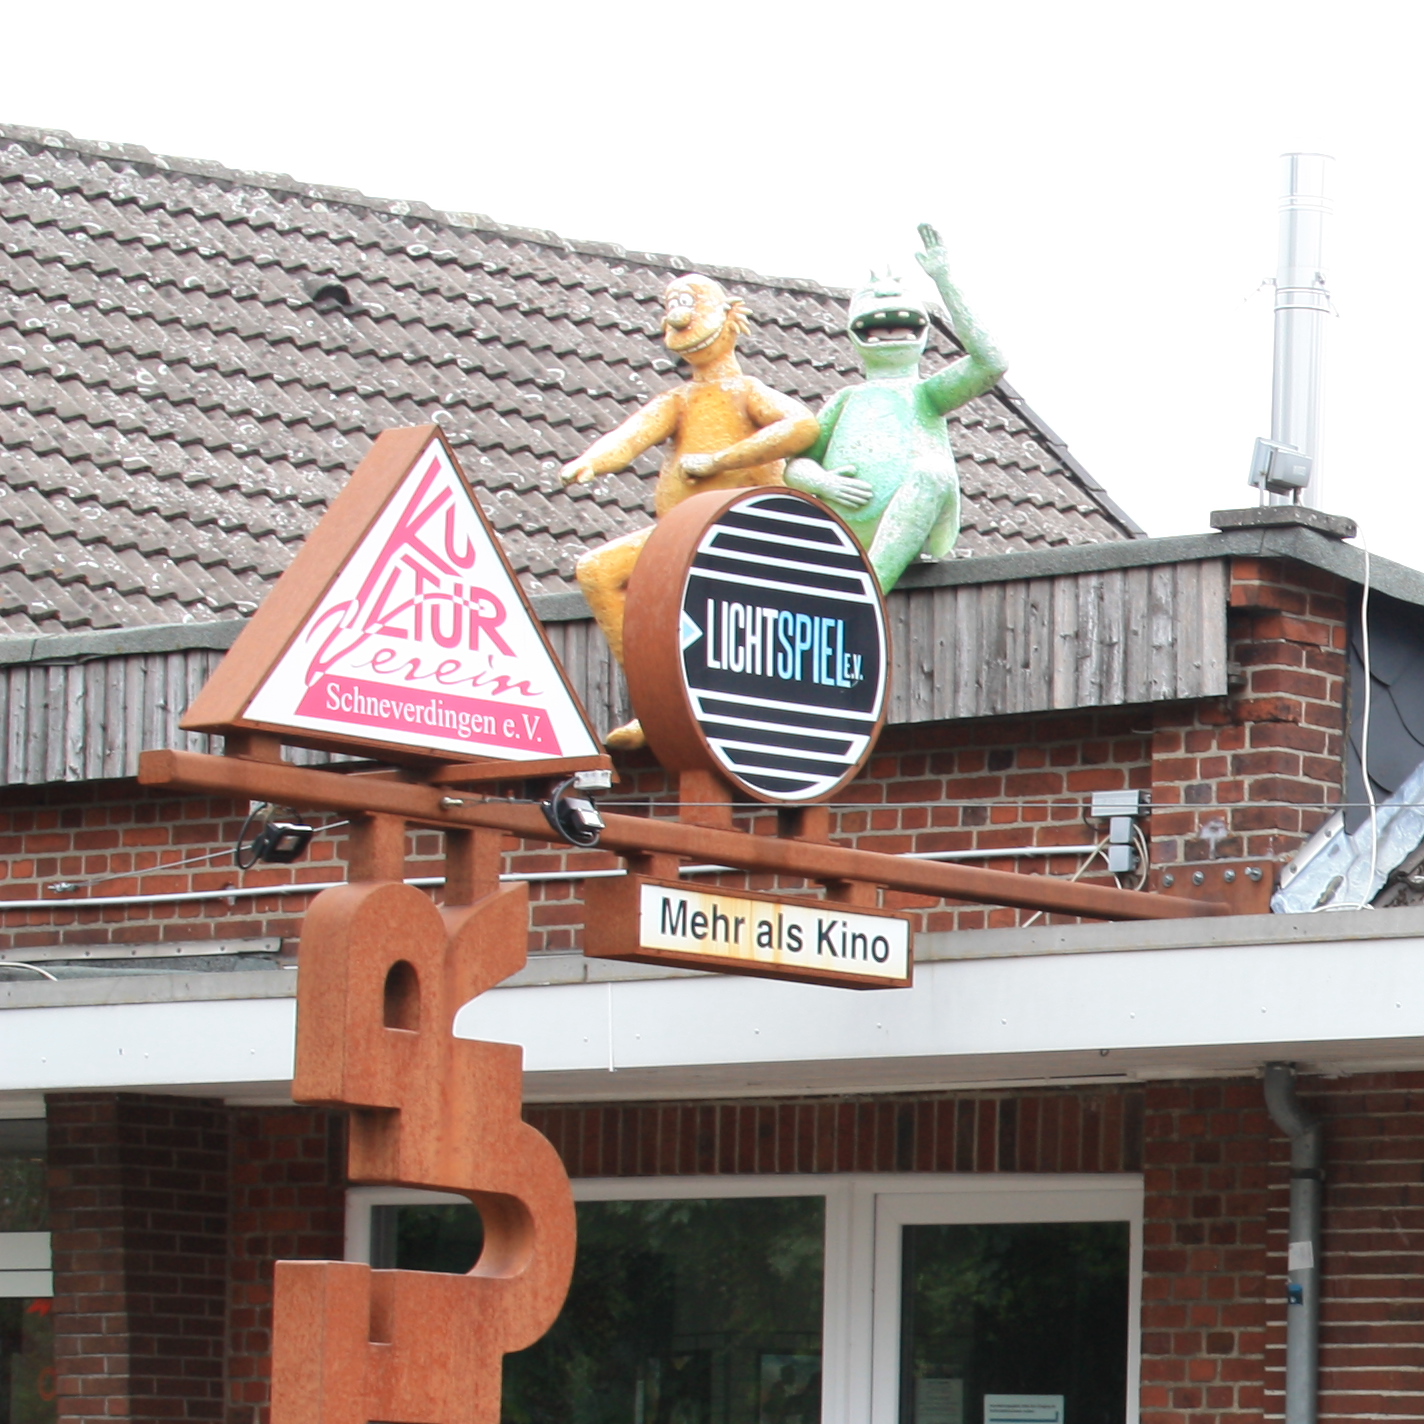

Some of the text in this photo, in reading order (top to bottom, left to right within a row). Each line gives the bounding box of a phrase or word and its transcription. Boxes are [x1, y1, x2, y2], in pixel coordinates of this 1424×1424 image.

[306, 594, 543, 696] Verein
[707, 599, 863, 687] LICHTSPIEL E.V.
[326, 682, 497, 737] Schneverdingen
[661, 896, 889, 963] Mehr als Kino
